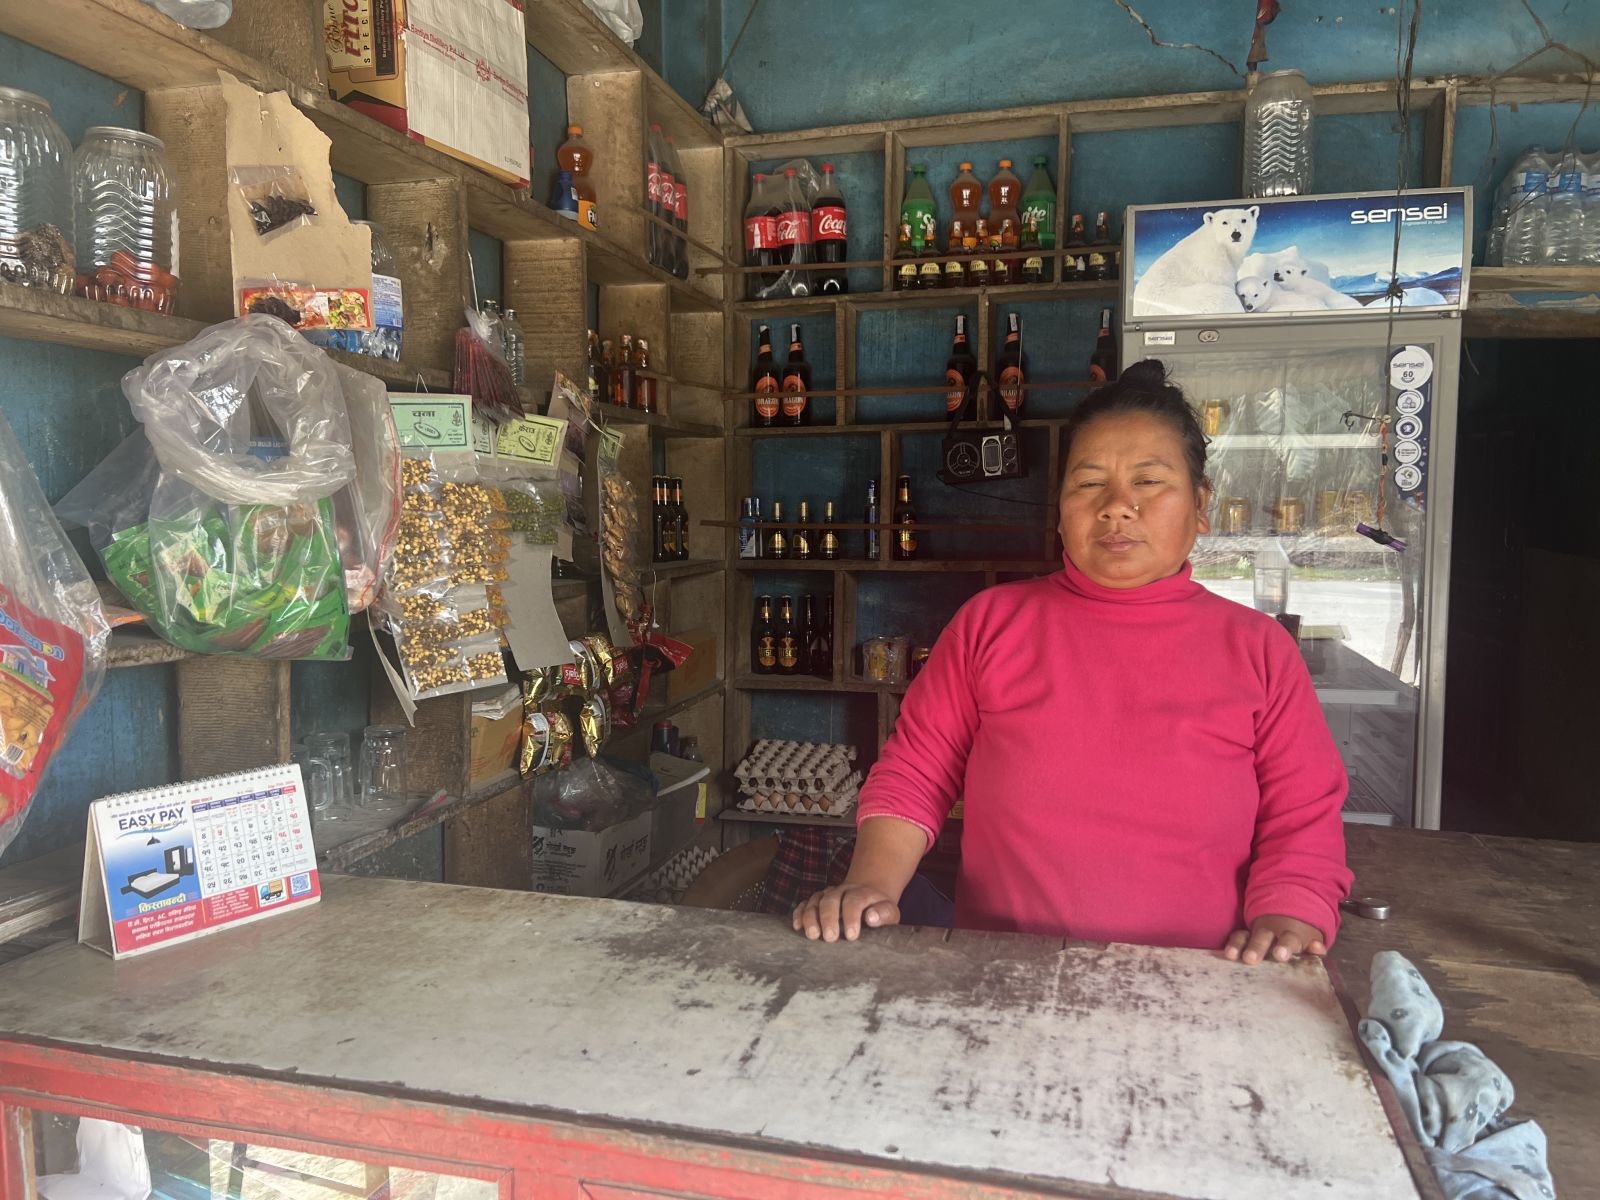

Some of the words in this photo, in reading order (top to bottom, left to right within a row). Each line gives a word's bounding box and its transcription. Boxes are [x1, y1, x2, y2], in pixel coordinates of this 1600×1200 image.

[1350, 202, 1448, 225] sensei
[118, 812, 156, 831] EASY
[159, 806, 184, 822] PAY
